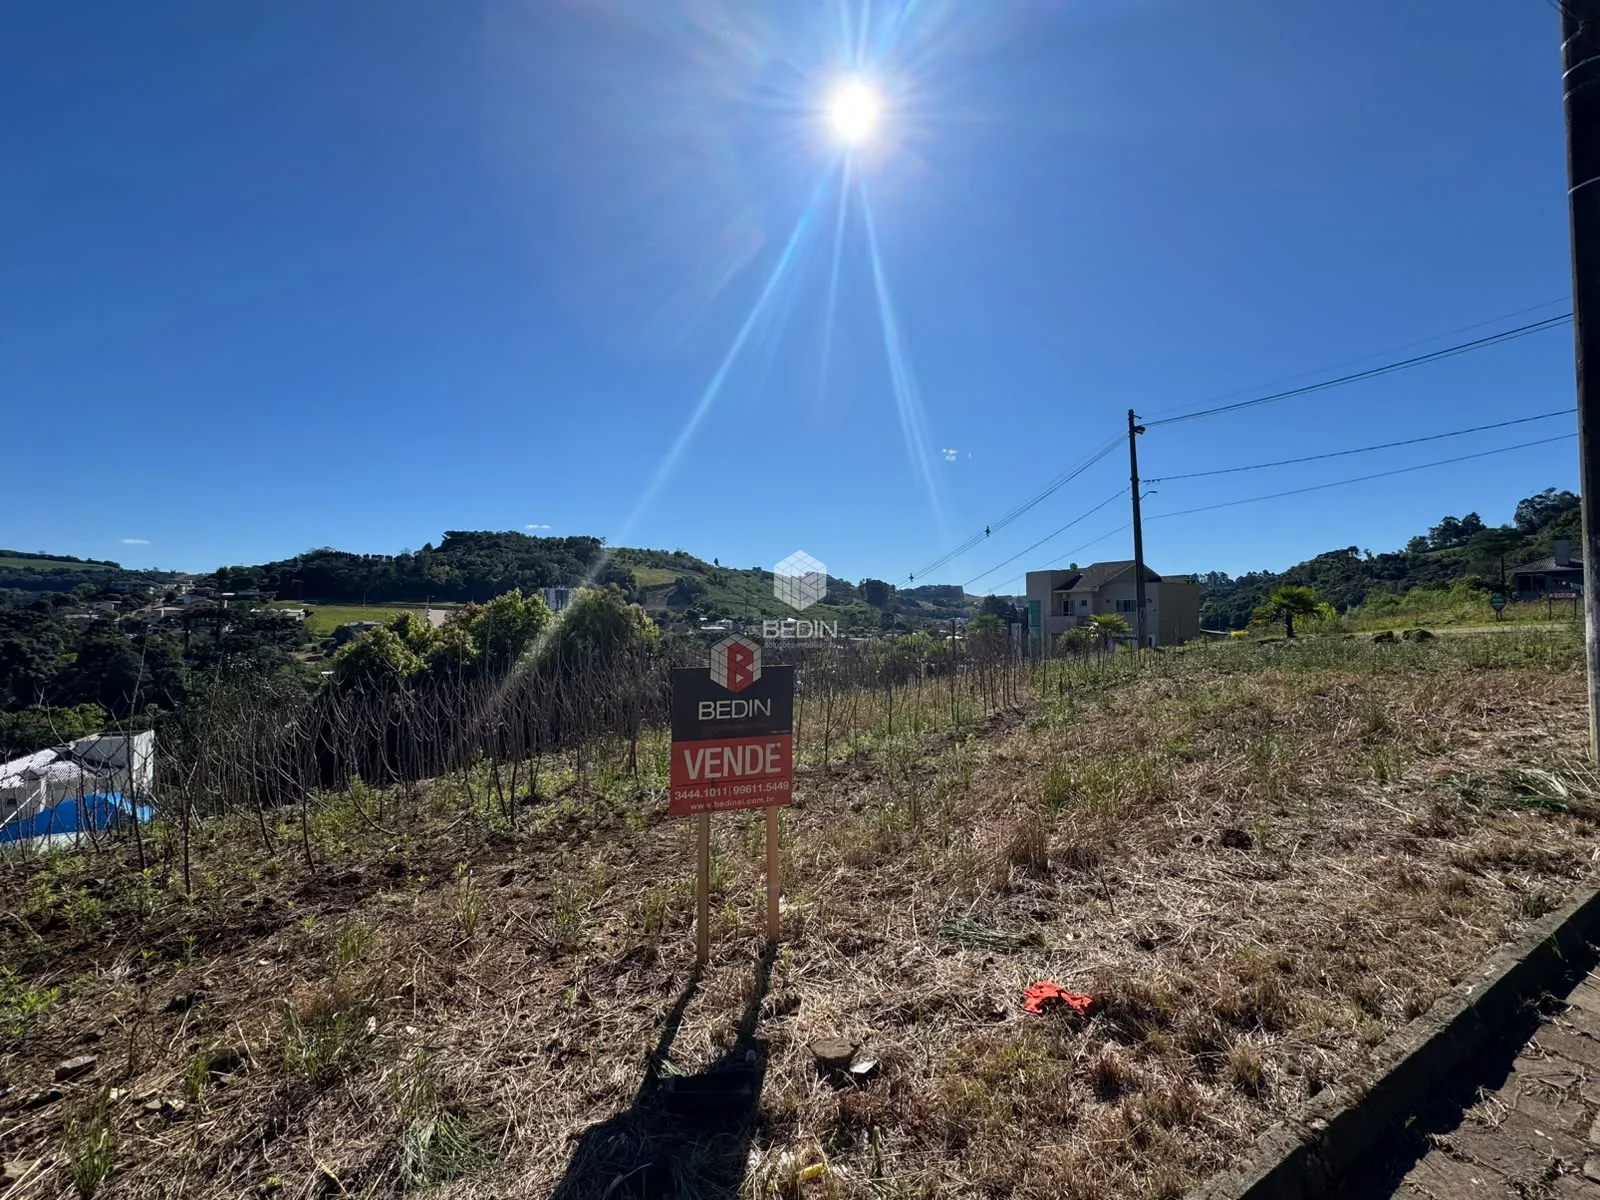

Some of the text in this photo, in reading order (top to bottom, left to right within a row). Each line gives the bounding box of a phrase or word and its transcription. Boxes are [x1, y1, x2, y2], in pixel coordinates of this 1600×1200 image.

[698, 698, 771, 721] BEDIN
[684, 742, 782, 780] VENDE
[690, 796, 775, 810] wwwbedinsi.com.br
